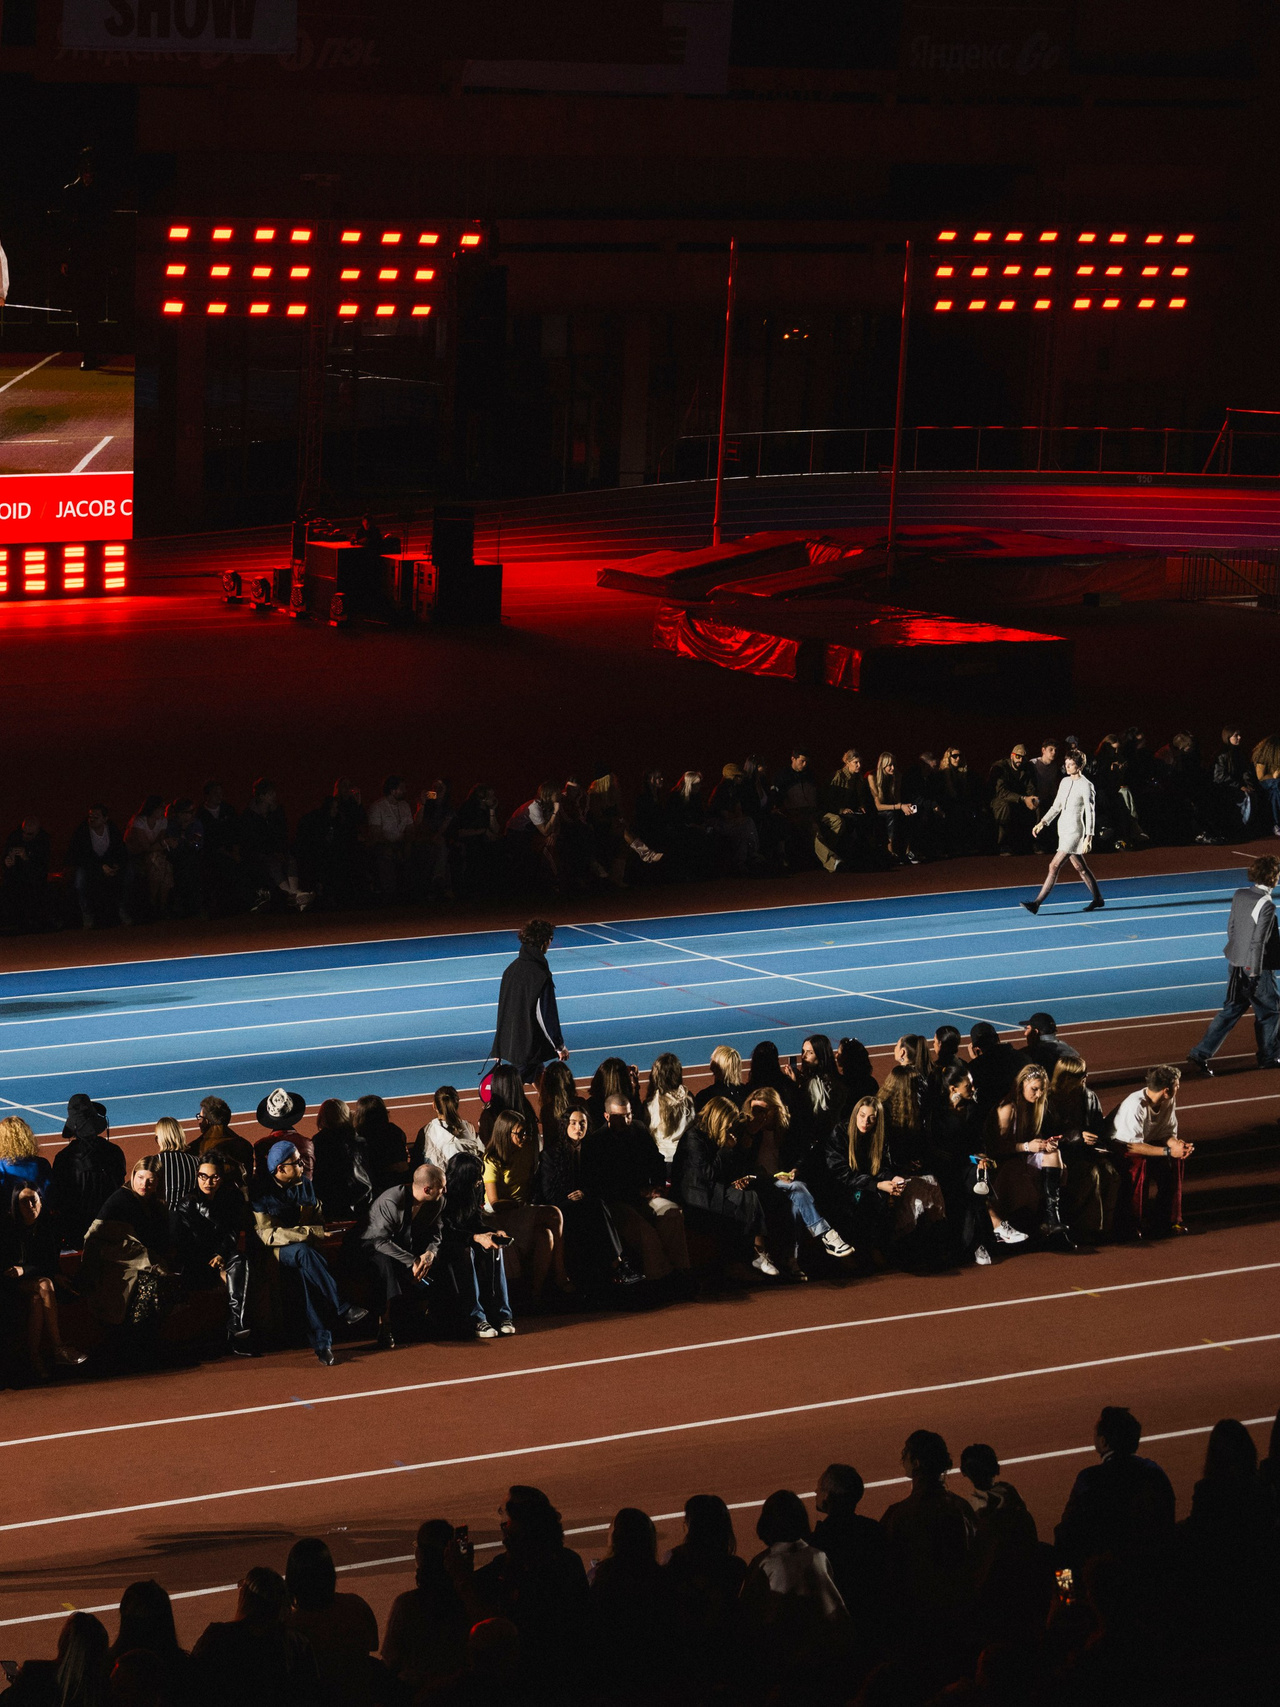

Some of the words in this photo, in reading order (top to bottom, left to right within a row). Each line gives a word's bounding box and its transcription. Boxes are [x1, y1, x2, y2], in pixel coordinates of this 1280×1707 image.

[104, 0, 256, 39] SHOW
[910, 35, 1010, 73] Яндекс
[55, 499, 116, 518] JACOB
[120, 498, 133, 516] C
